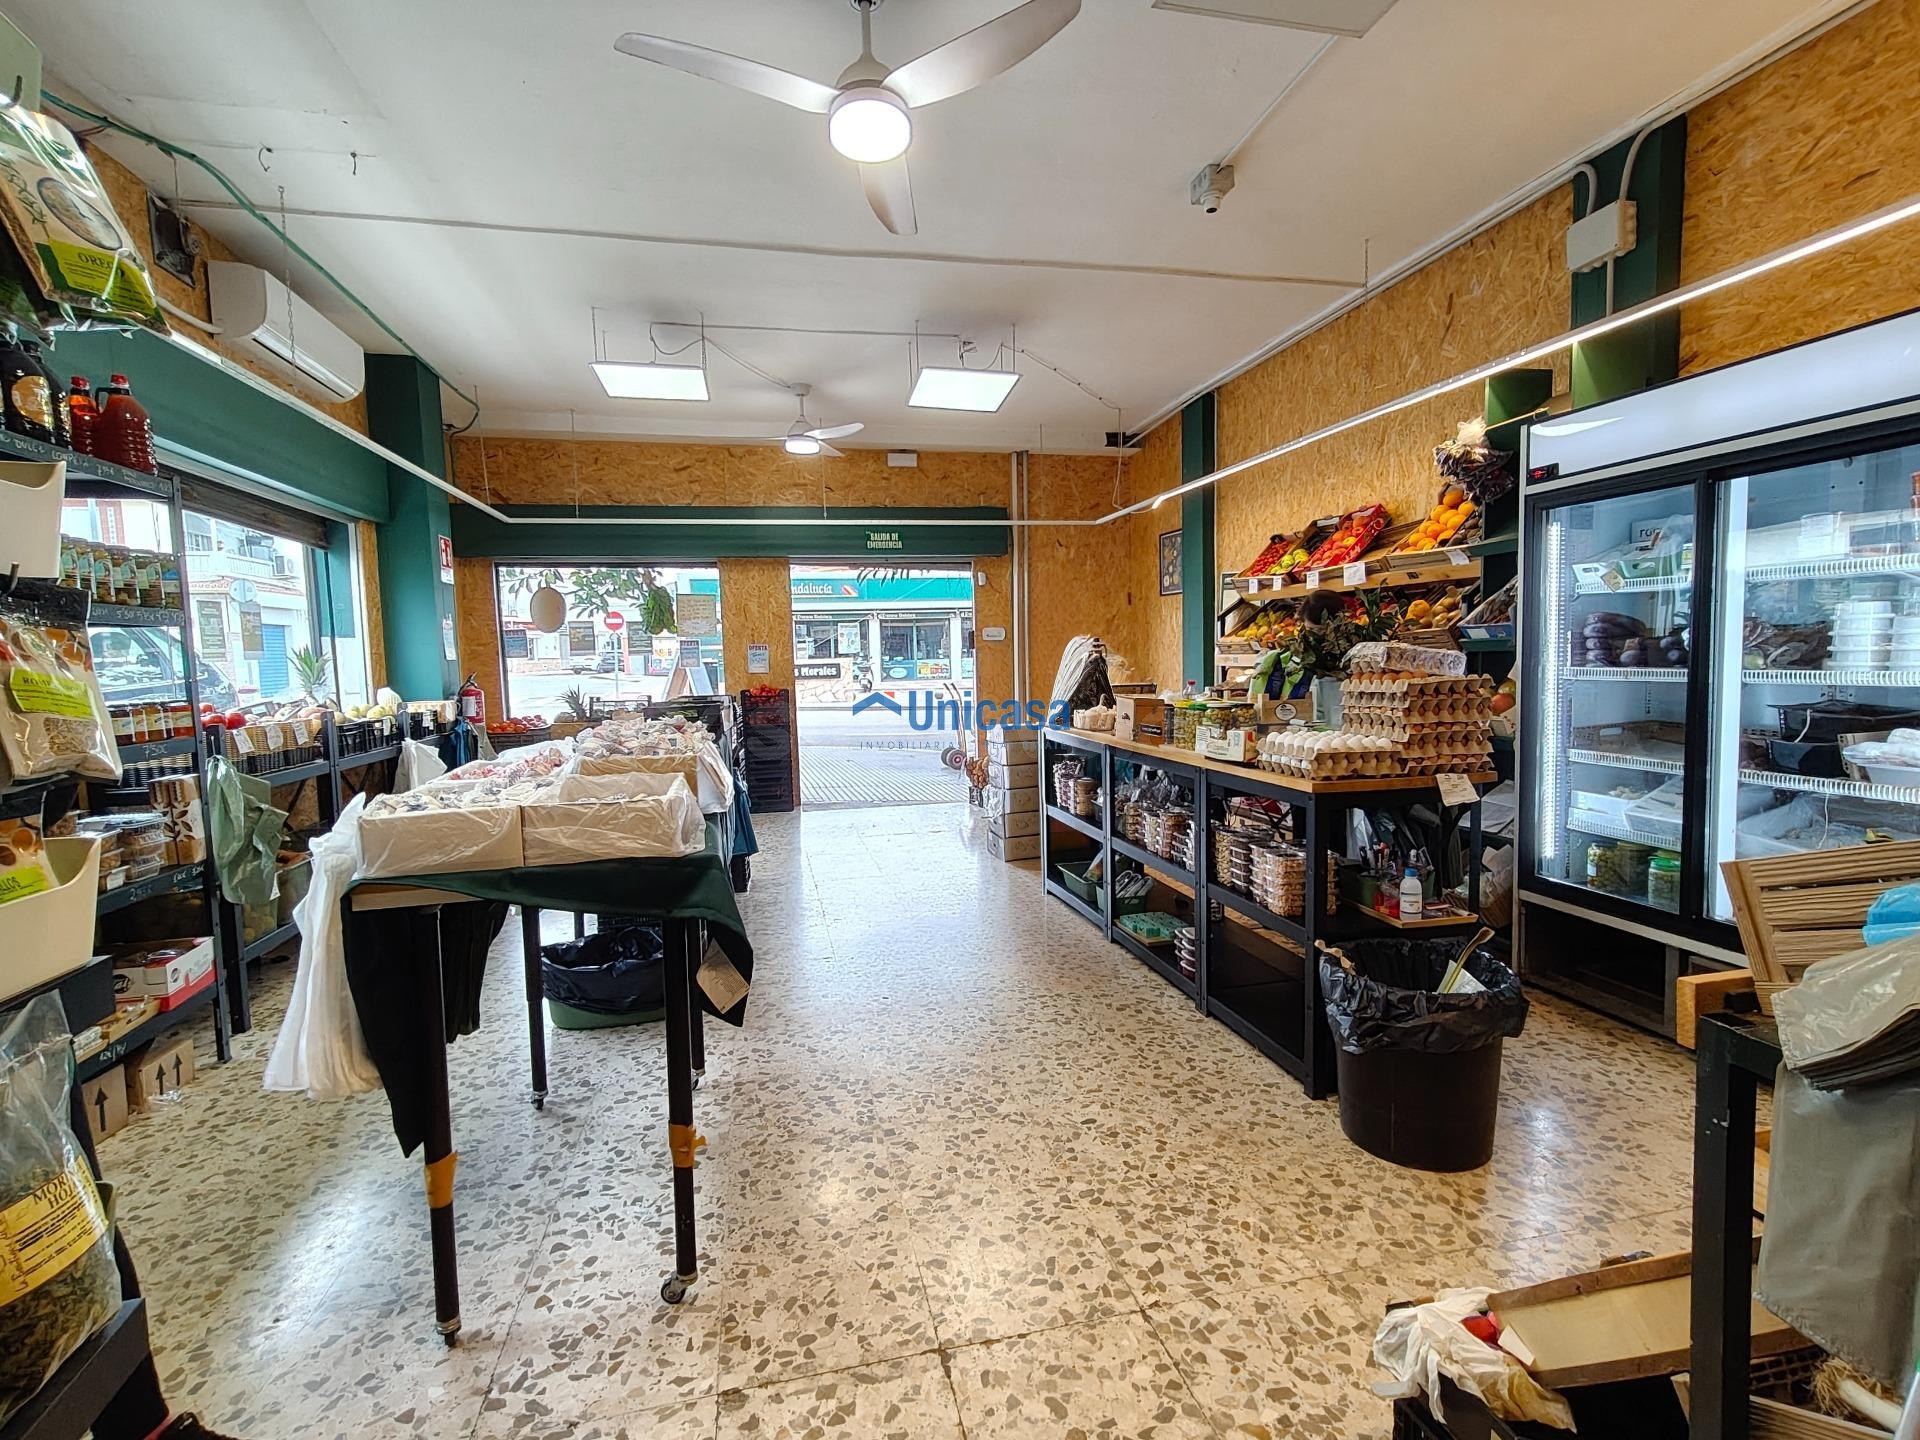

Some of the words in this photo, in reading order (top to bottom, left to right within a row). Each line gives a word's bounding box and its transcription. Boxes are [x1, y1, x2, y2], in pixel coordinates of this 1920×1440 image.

[870, 532, 890, 541] SALIDA
[891, 532, 899, 541] DE
[866, 541, 903, 549] EMERGENCIA
[801, 665, 837, 677] Morales
